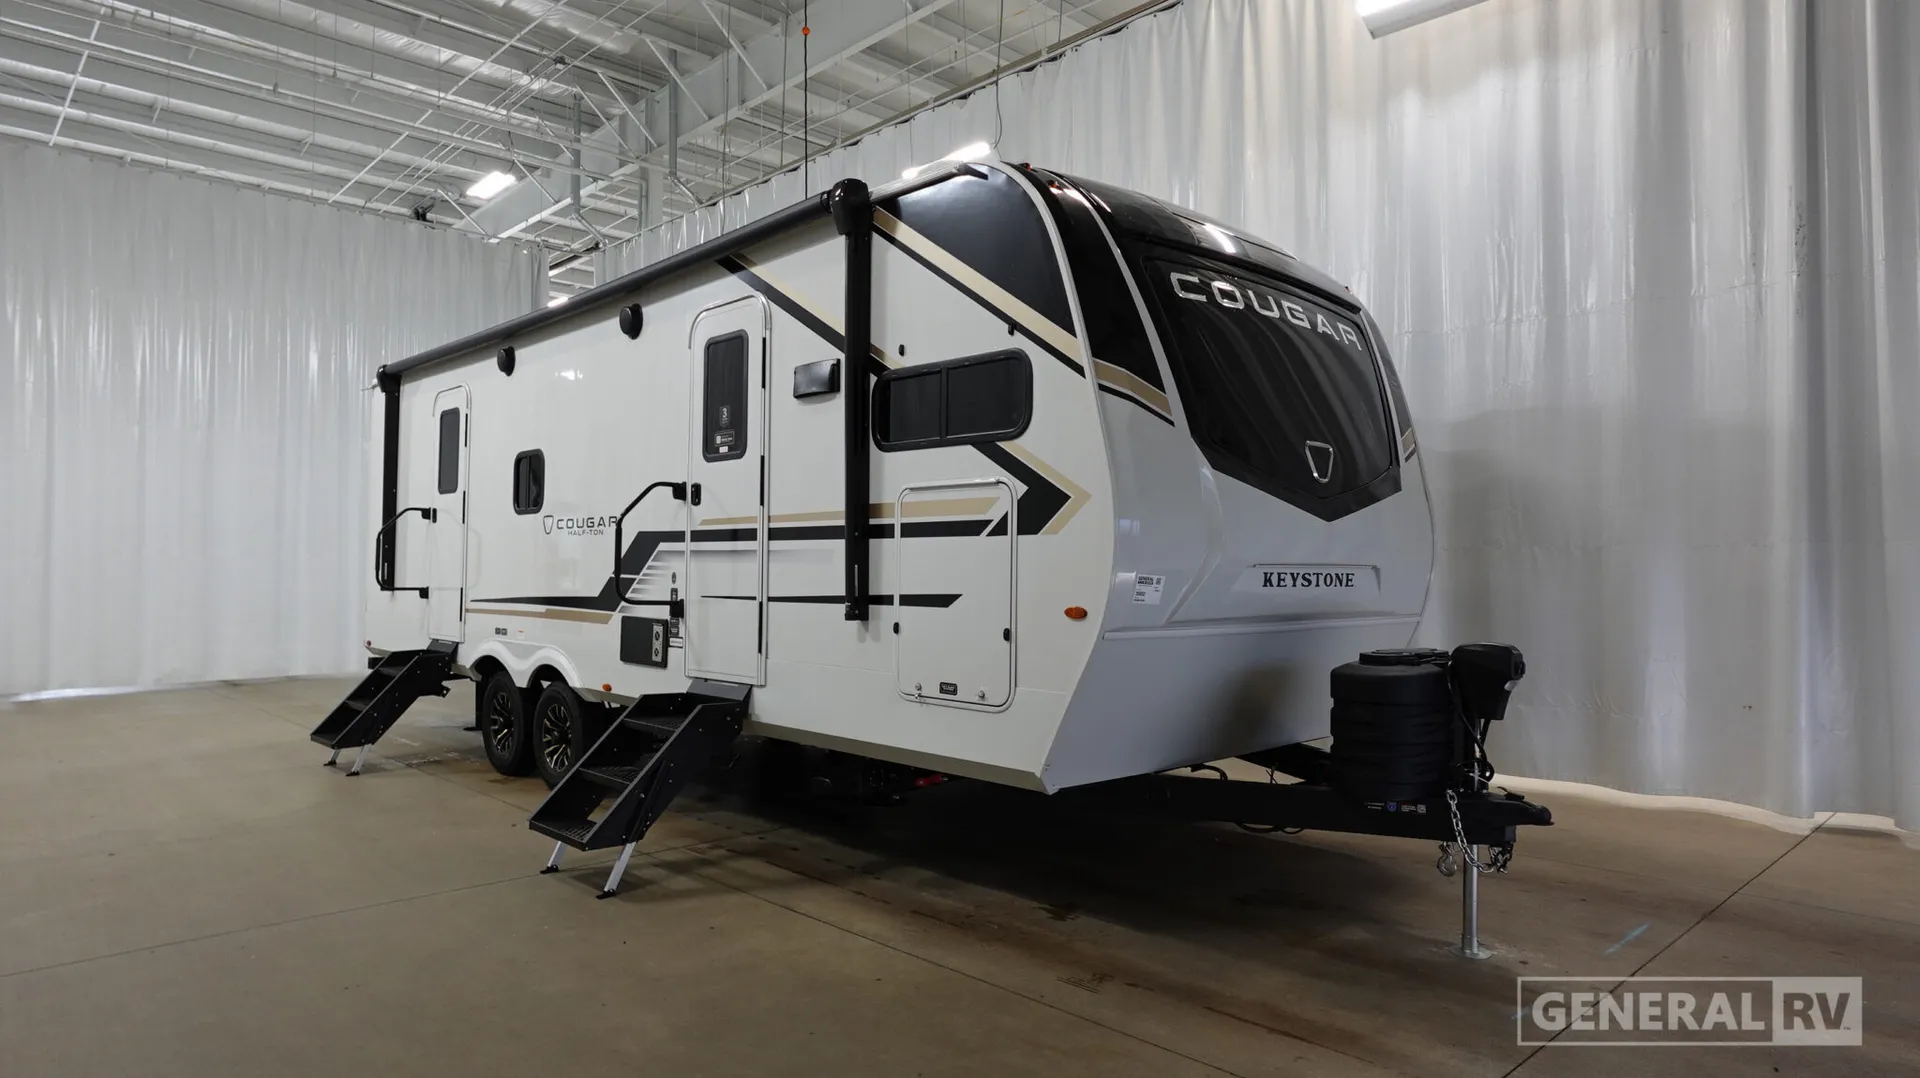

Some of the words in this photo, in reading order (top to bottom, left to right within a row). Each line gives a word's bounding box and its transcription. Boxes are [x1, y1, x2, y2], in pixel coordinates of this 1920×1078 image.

[1170, 272, 1362, 351] COUGAR
[722, 407, 728, 418] 3
[556, 516, 618, 530] COUGAR
[1262, 571, 1355, 588] KEYSTONE
